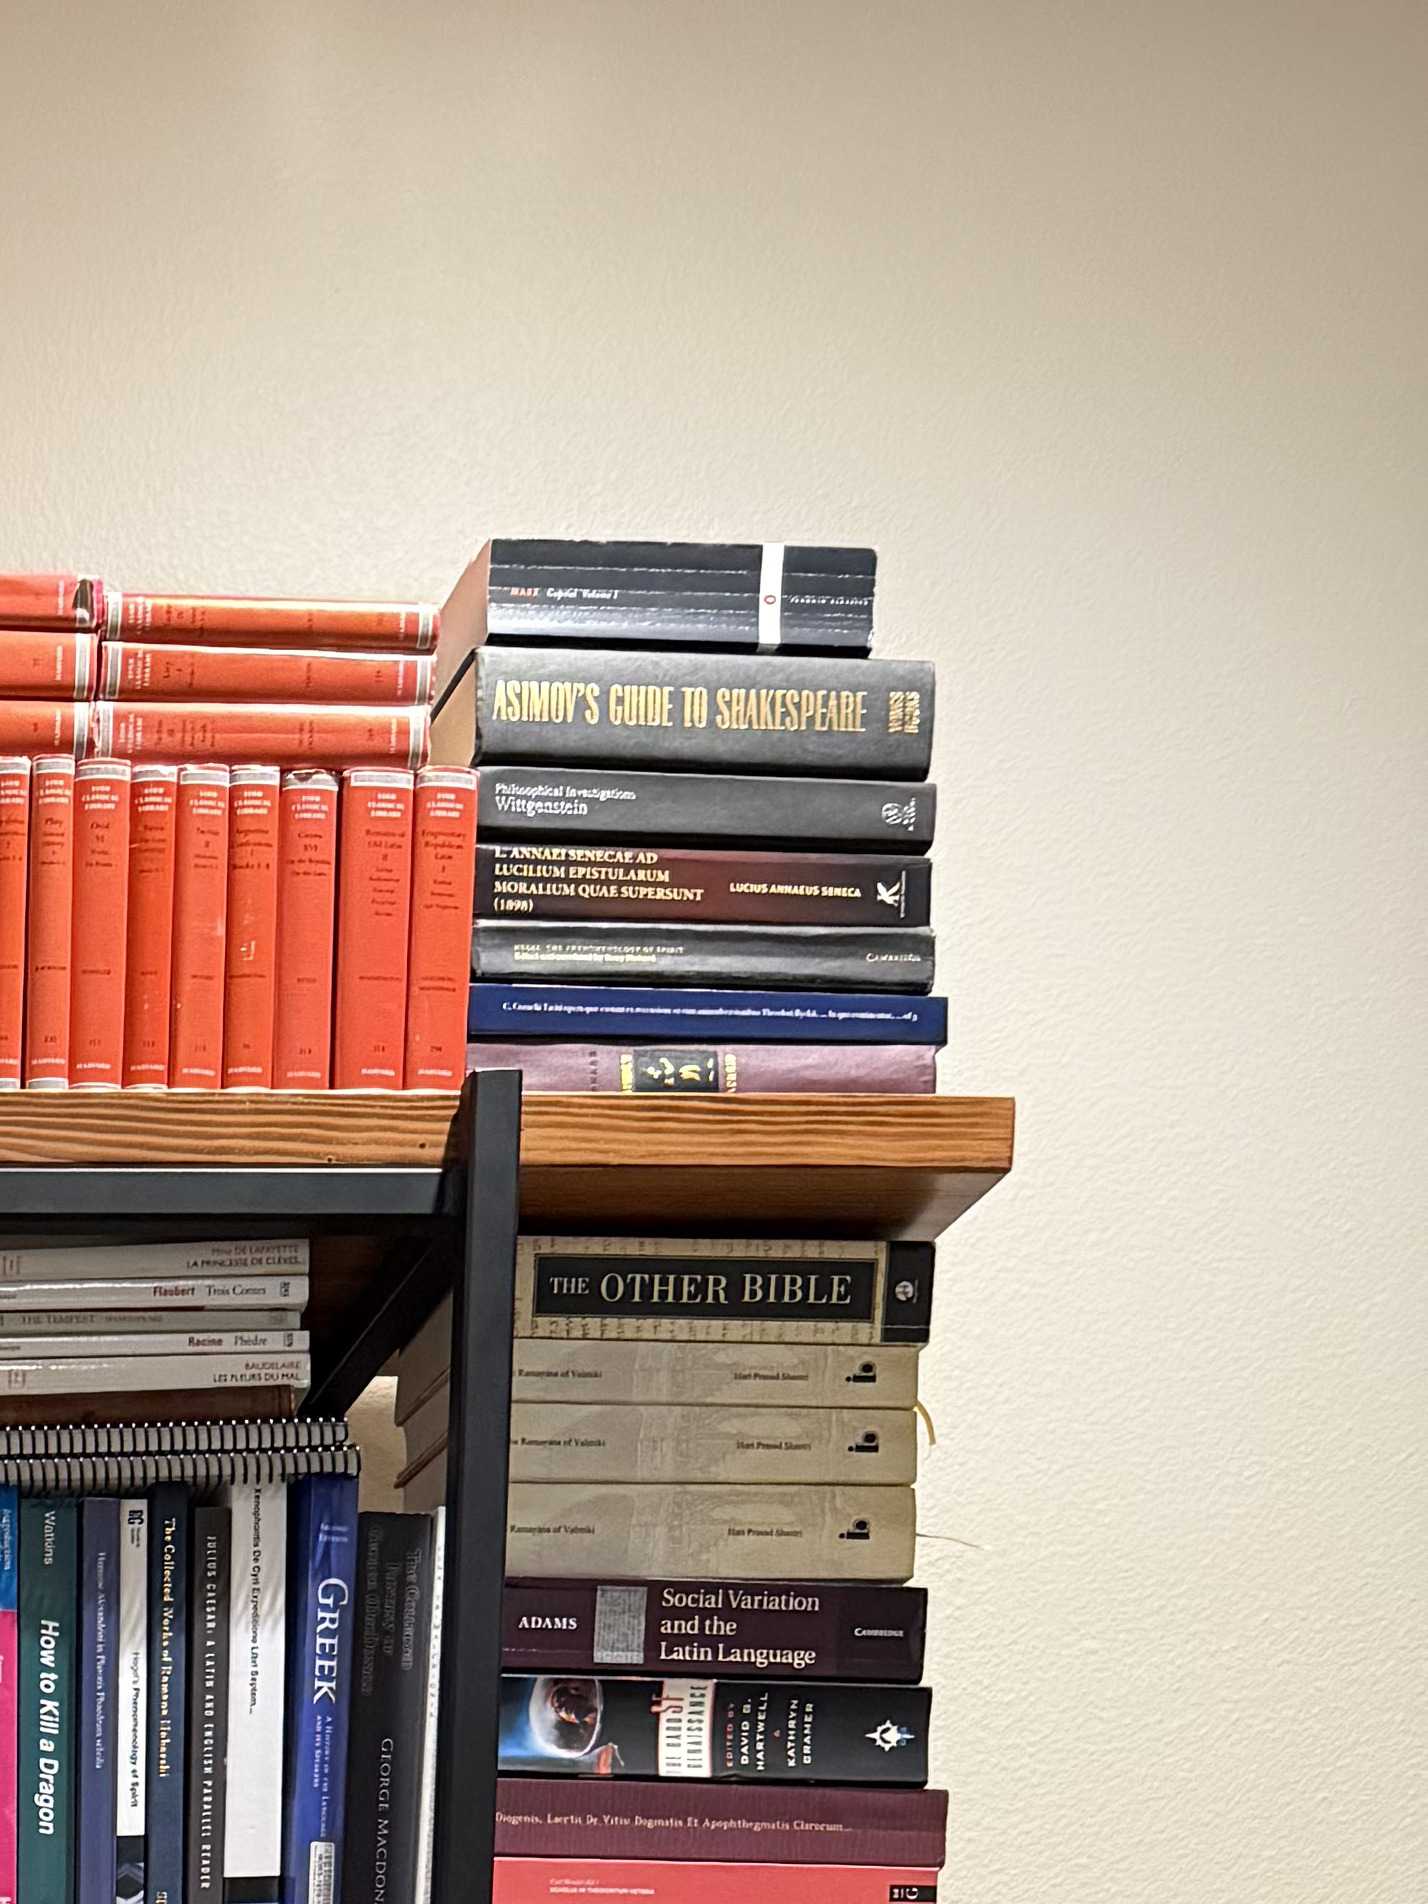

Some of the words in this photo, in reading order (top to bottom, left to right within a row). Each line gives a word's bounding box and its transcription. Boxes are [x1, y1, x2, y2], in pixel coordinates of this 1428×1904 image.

[493, 681, 600, 723] ASIMOV'S
[609, 684, 672, 727] GUIDE
[682, 687, 708, 728] TO
[716, 690, 867, 732] SHAKESPEARE
[549, 1276, 590, 1295] THE
[600, 1273, 727, 1305] OTHER
[743, 1273, 852, 1306] BIBLE
[661, 1589, 722, 1609] Social
[727, 1593, 820, 1612] Variation
[518, 1615, 578, 1631] ADAMS
[660, 1617, 698, 1635] and
[704, 1618, 736, 1636] the
[39, 1618, 60, 1668] How
[316, 1577, 348, 1704] GREEK
[659, 1644, 712, 1663] Latin
[717, 1645, 816, 1667] Language
[38, 1671, 59, 1695] to
[38, 1699, 61, 1736] Kill
[38, 1740, 56, 1754] a
[33, 1757, 61, 1836] Dragon
